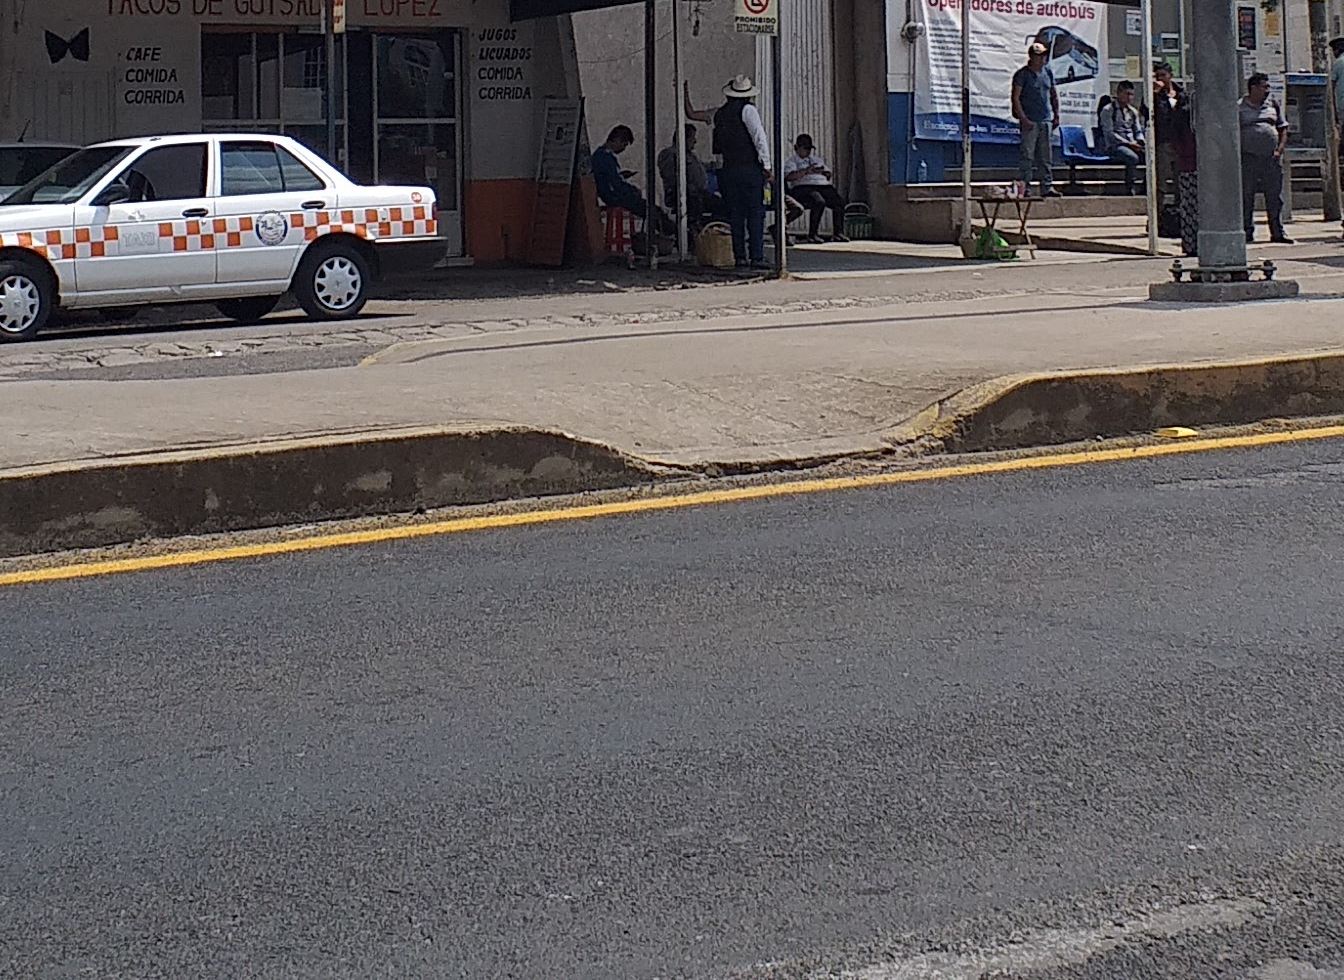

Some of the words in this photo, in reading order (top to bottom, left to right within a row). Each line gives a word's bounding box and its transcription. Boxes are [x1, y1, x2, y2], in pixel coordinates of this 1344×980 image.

[1036, 1, 1096, 20] autobús
[734, 16, 776, 24] PROHIBIDO
[478, 28, 518, 41] JUGOS
[126, 47, 162, 62] CAFE
[478, 47, 533, 61] LICUADOS
[125, 68, 178, 83] COMIDA
[478, 67, 524, 81] COMIDA
[124, 89, 186, 105] CORRIDA
[478, 86, 533, 101] CORRIDA
